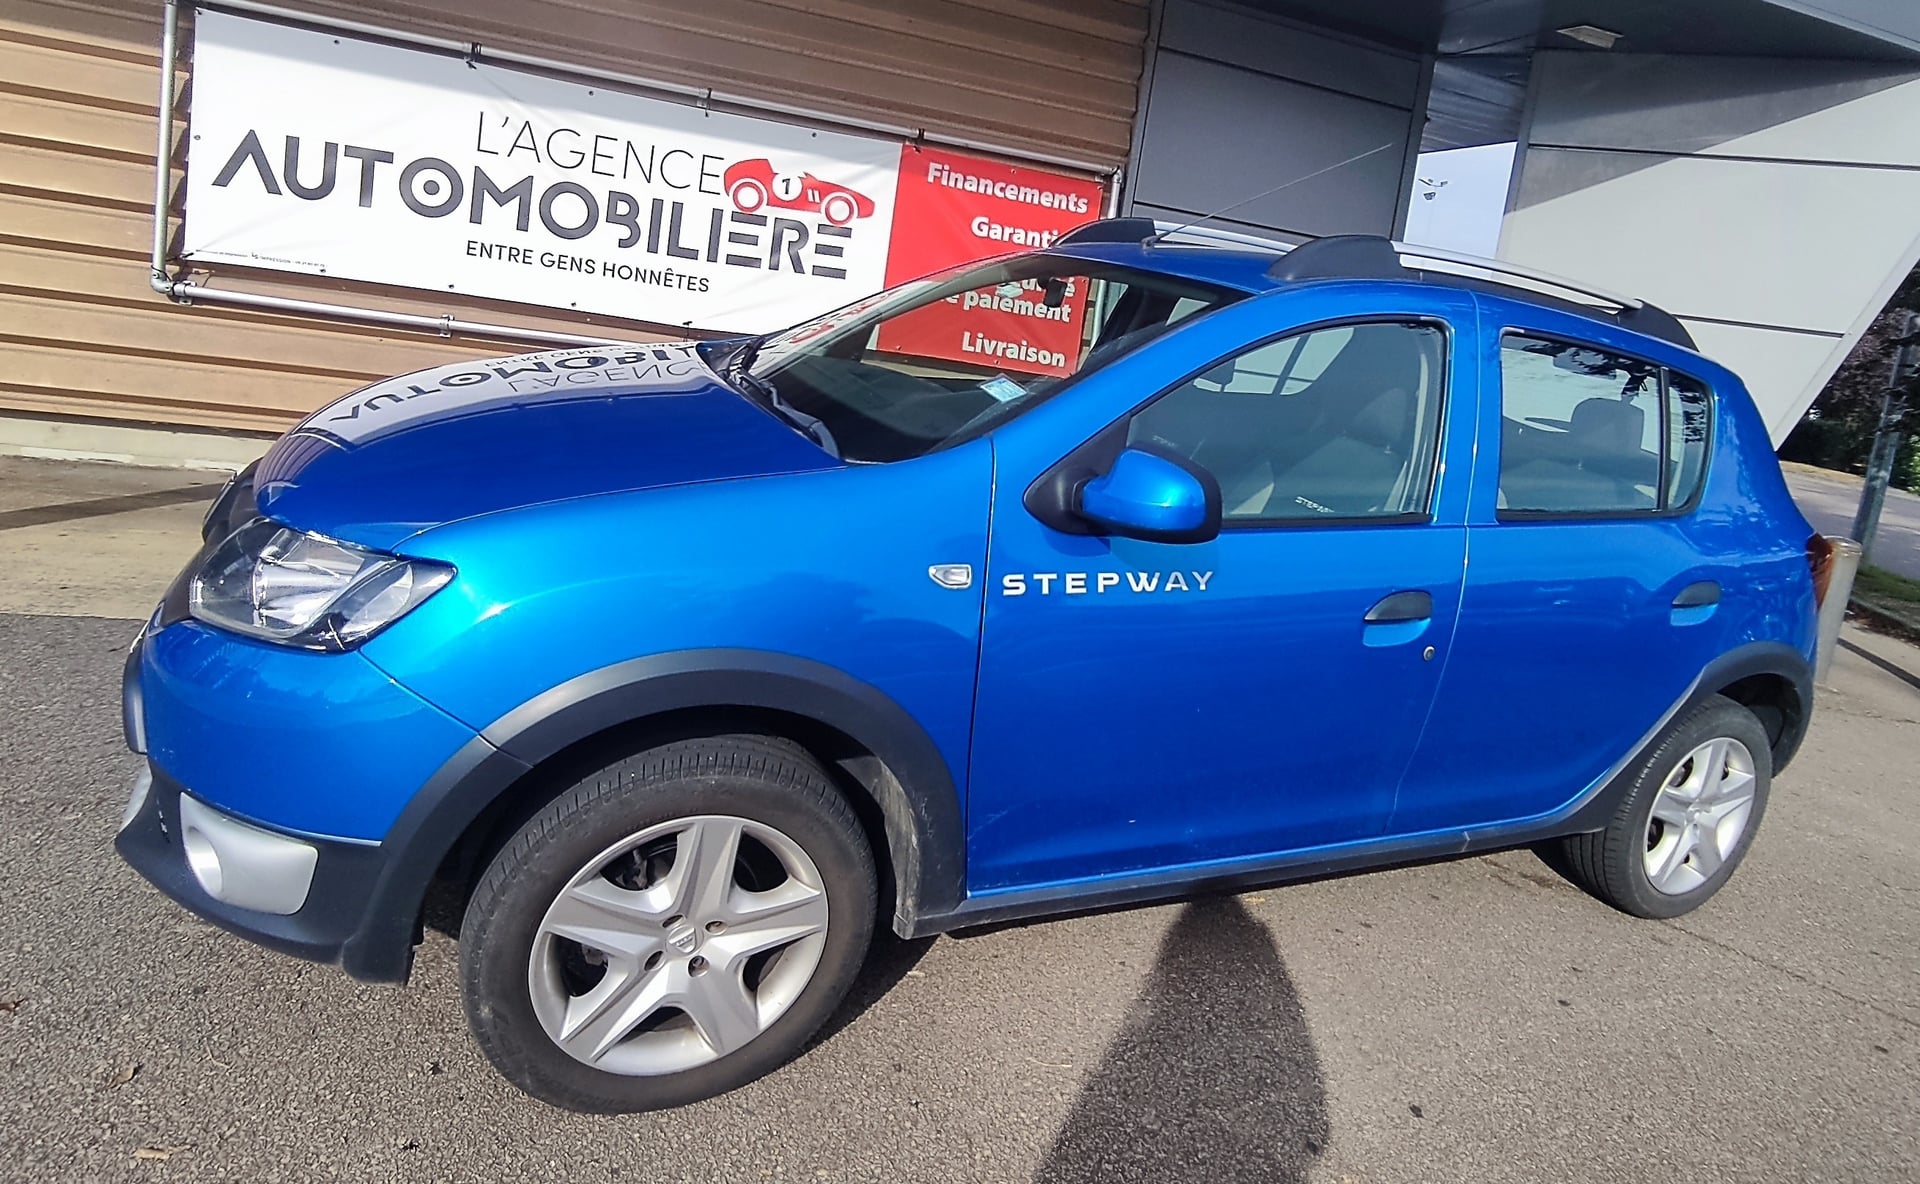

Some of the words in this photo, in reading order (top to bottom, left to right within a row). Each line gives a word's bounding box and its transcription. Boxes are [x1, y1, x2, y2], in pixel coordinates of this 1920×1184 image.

[476, 110, 725, 196] L'AGENCE
[781, 178, 791, 195] 1
[927, 162, 1088, 214] Financements
[971, 216, 1059, 249] Garanti
[466, 240, 534, 265] ENTRE
[540, 252, 596, 275] GENS
[602, 262, 710, 293] HONNÊTES
[963, 290, 1072, 322] paiement
[962, 331, 1066, 367] Livraison
[1002, 570, 1214, 597] STEPWAY
